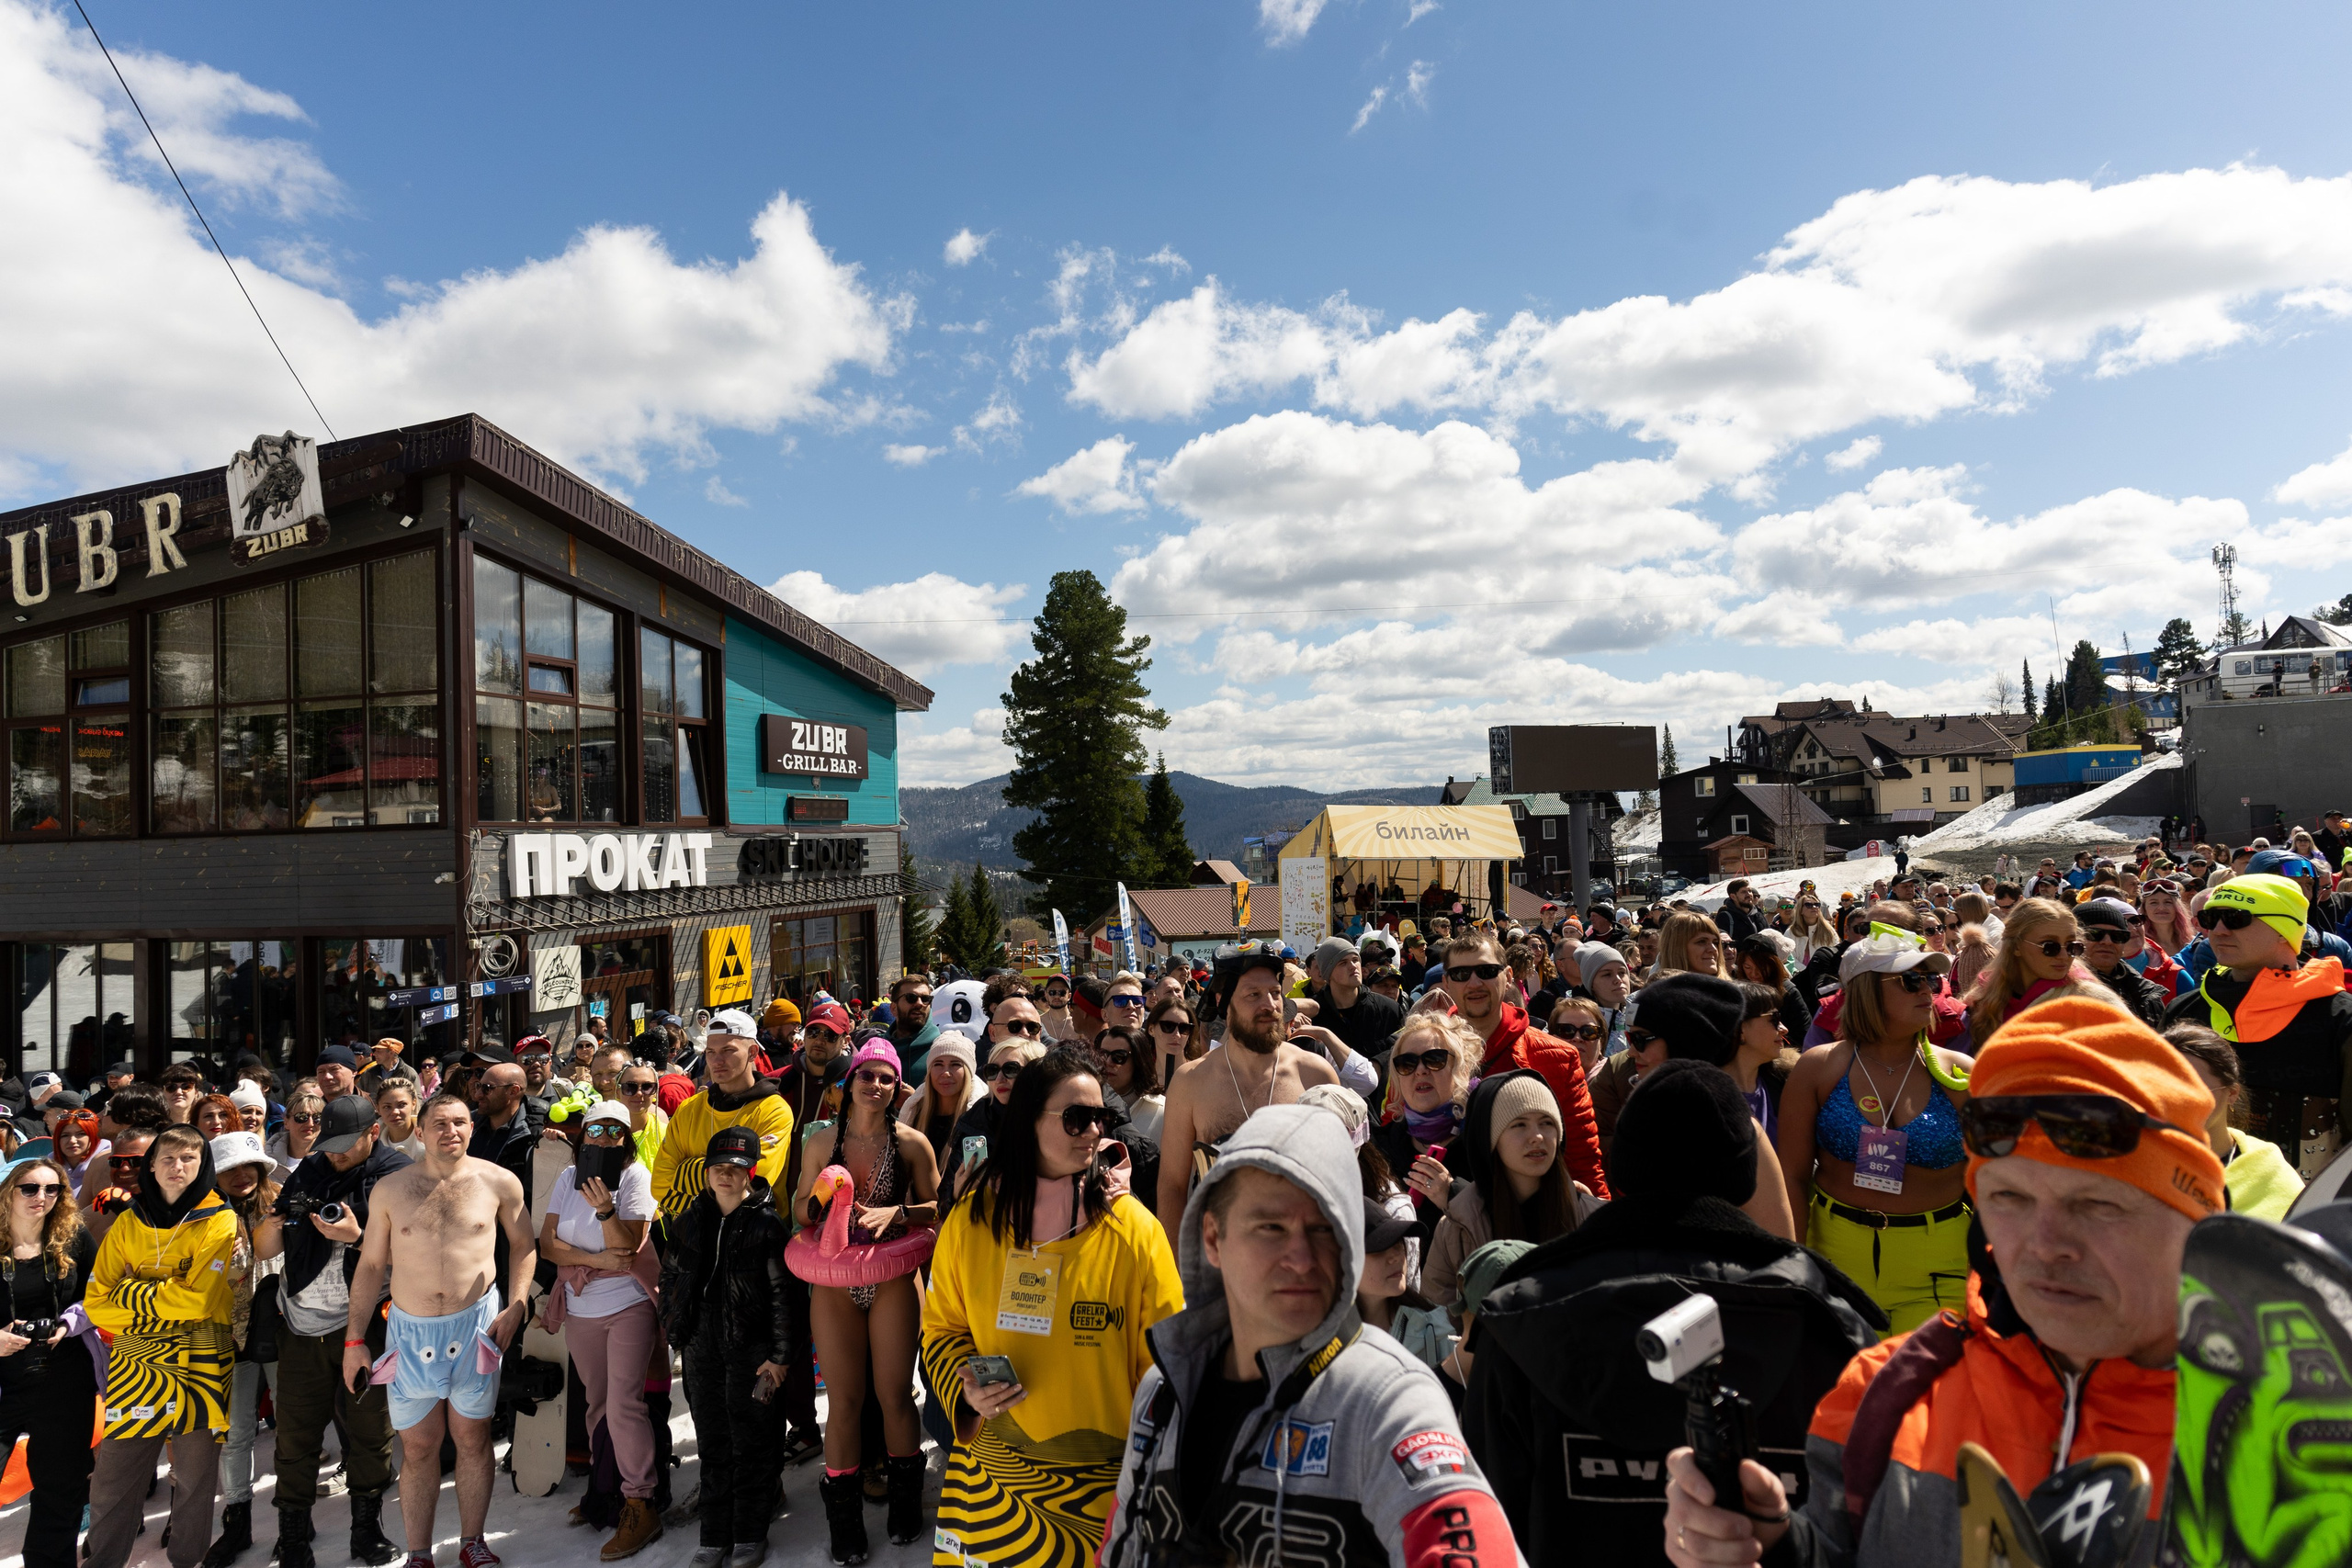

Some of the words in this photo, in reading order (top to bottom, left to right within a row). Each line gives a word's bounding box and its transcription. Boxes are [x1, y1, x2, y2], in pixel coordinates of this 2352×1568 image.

[5, 491, 187, 607] UBR
[245, 524, 310, 558] ZUBR
[791, 721, 848, 755] ZUBR
[1375, 820, 1470, 840] билайн
[507, 833, 713, 897] ПРОКАТ
[746, 839, 792, 875] SKI
[802, 837, 869, 873] HOUSE
[714, 980, 747, 992] FISCHER
[718, 1138, 746, 1149] FIRE
[1869, 1162, 1891, 1173] 867
[1011, 1291, 1046, 1303] ВОЛОНТЕР
[1076, 1305, 1105, 1316] GRELKA
[1075, 1316, 1095, 1326] FEST
[1307, 1337, 1343, 1377] Nikon
[1306, 1435, 1328, 1462] 88
[945, 1538, 959, 1551] 2ГИС
